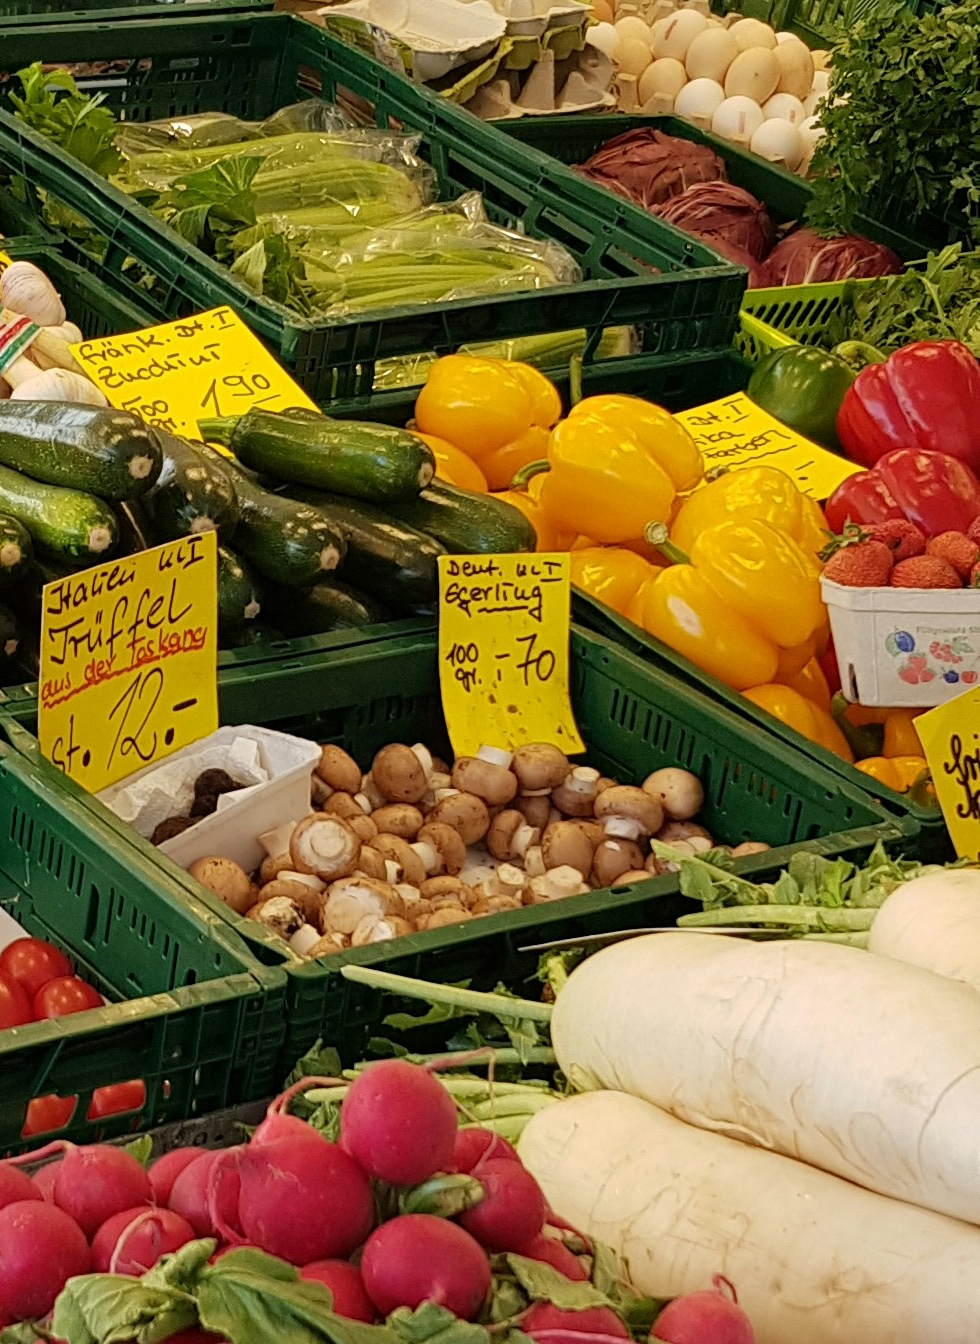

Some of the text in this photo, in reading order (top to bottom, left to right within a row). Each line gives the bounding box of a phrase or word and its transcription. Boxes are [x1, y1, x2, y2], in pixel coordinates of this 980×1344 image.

[121, 395, 169, 418] 500
[444, 581, 543, 624] Egerling
[48, 577, 194, 665] Trüffel
[445, 642, 480, 668] 100
[41, 671, 72, 701] aus
[84, 653, 117, 682] der
[454, 667, 483, 694] gr.
